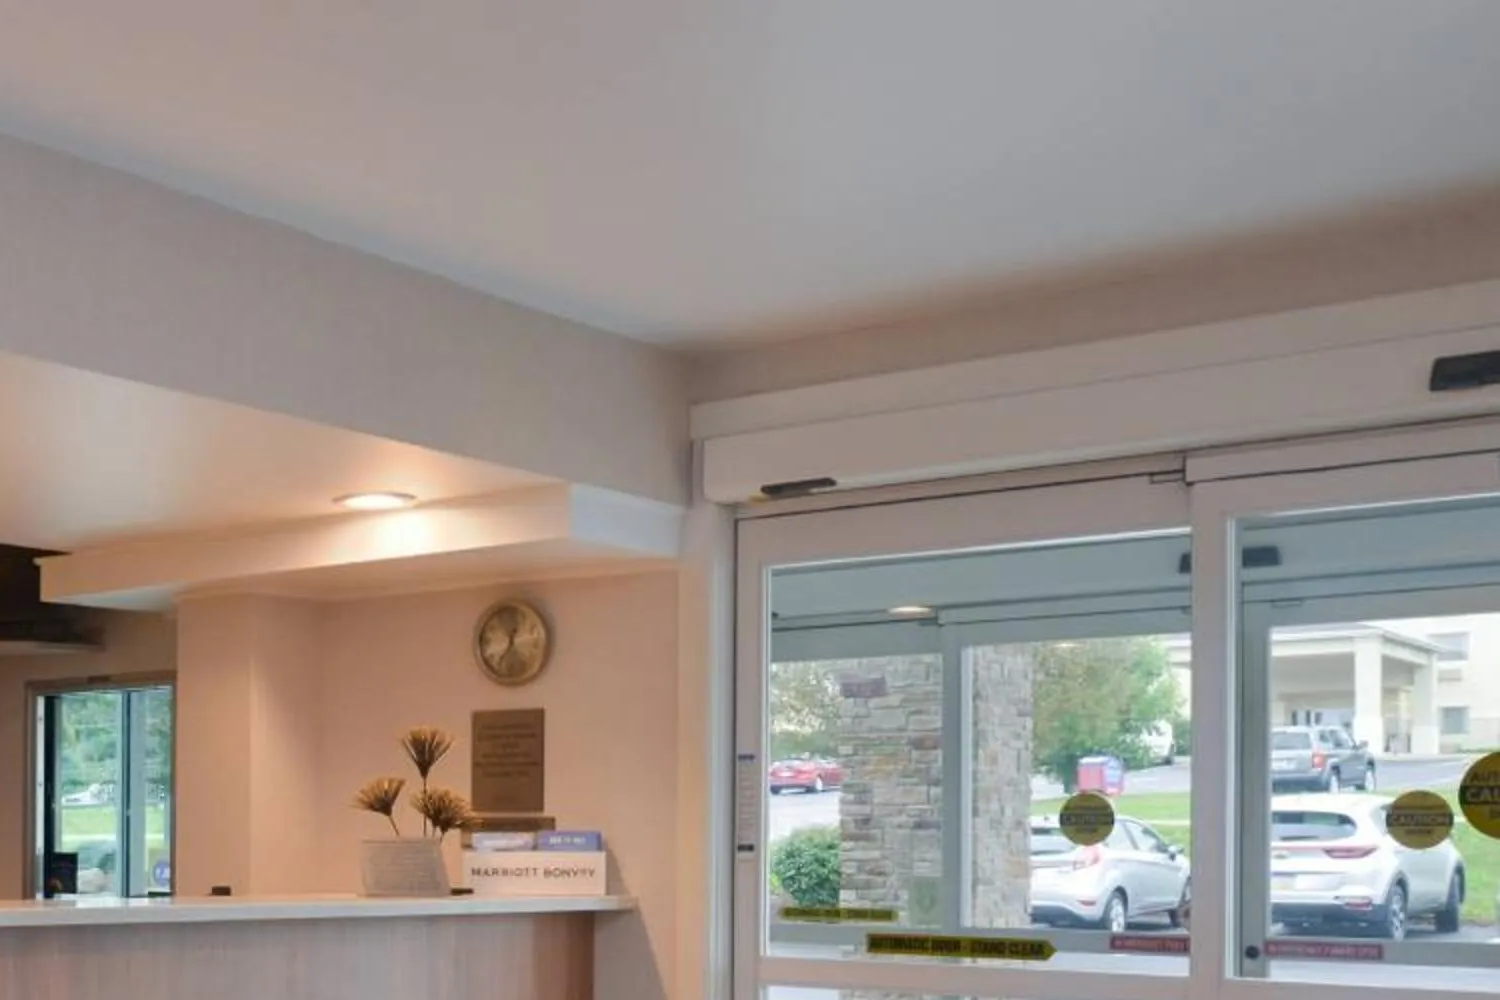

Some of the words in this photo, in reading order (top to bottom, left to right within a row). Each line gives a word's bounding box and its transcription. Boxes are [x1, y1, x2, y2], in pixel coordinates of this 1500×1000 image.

[1391, 814, 1449, 826] CAUTION
[471, 867, 538, 877] MARRIOTT
[1008, 942, 1045, 956] CLEAR
